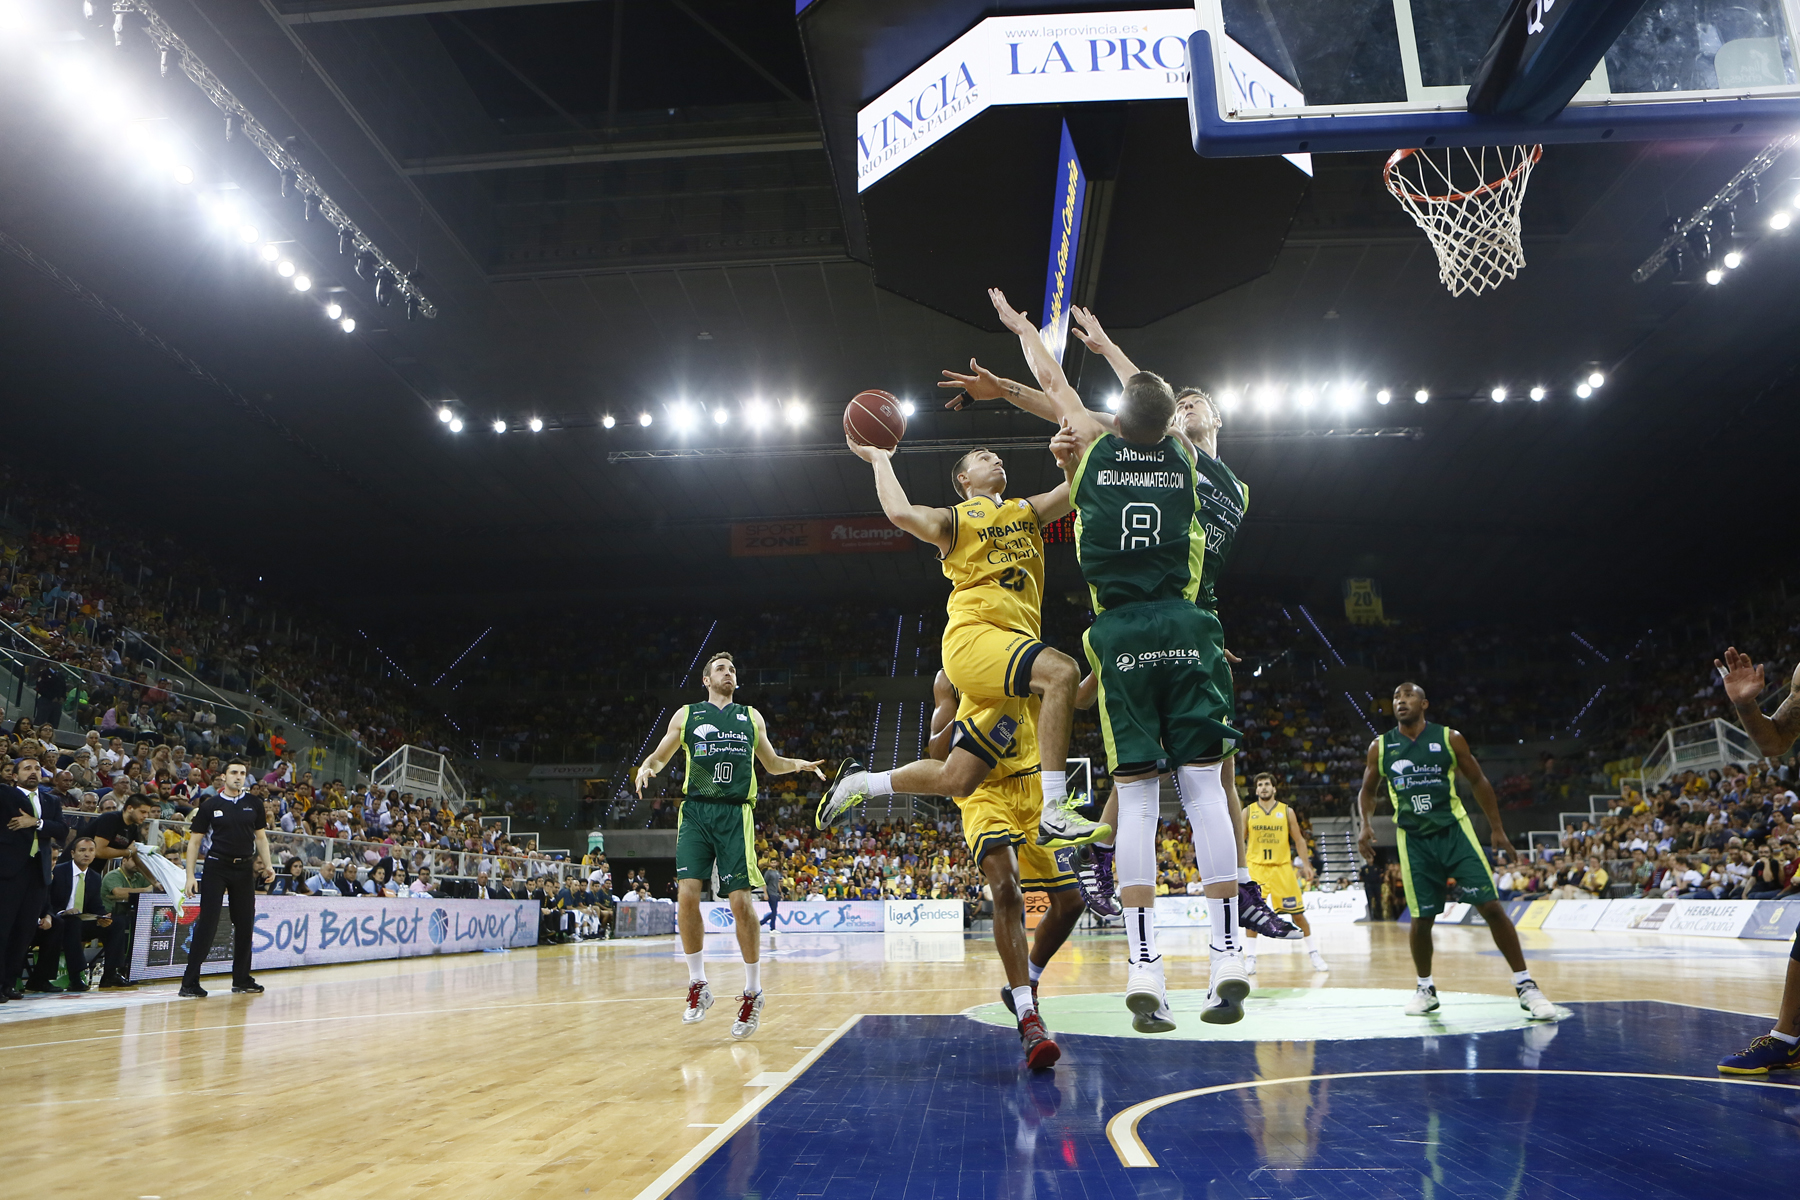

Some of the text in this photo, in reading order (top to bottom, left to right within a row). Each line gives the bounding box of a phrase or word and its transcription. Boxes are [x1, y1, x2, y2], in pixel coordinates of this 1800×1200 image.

[1005, 23, 1139, 38] www.laprovincia.es
[1005, 41, 1078, 75] LA
[885, 142, 901, 161] DE
[902, 126, 924, 153] LAS
[926, 88, 980, 133] PALMAS
[1062, 159, 1079, 235] Canaria
[1058, 231, 1070, 276] Gran
[1096, 470, 1184, 489] MEDULAPARAMATEO.COM
[746, 523, 807, 536] SPORT
[1120, 502, 1161, 550] 8
[745, 535, 808, 548] ZONE
[1205, 522, 1226, 554] 17
[1000, 567, 1028, 592] 23
[1353, 591, 1373, 606] 20
[1138, 650, 1168, 661] COSTA
[1169, 649, 1187, 657] DEL
[717, 731, 748, 741] Unicaja
[712, 761, 733, 783] 10
[1412, 764, 1442, 774] Unicaja
[1411, 794, 1433, 815] 15
[1263, 849, 1272, 860] 11
[846, 909, 861, 921] liga
[889, 905, 960, 925] liga endesa
[1684, 905, 1738, 917] HERBALIFE
[251, 907, 510, 954] Soy Basket Lover
[1670, 918, 1693, 931] Gran
[1694, 917, 1734, 932] Canaria
